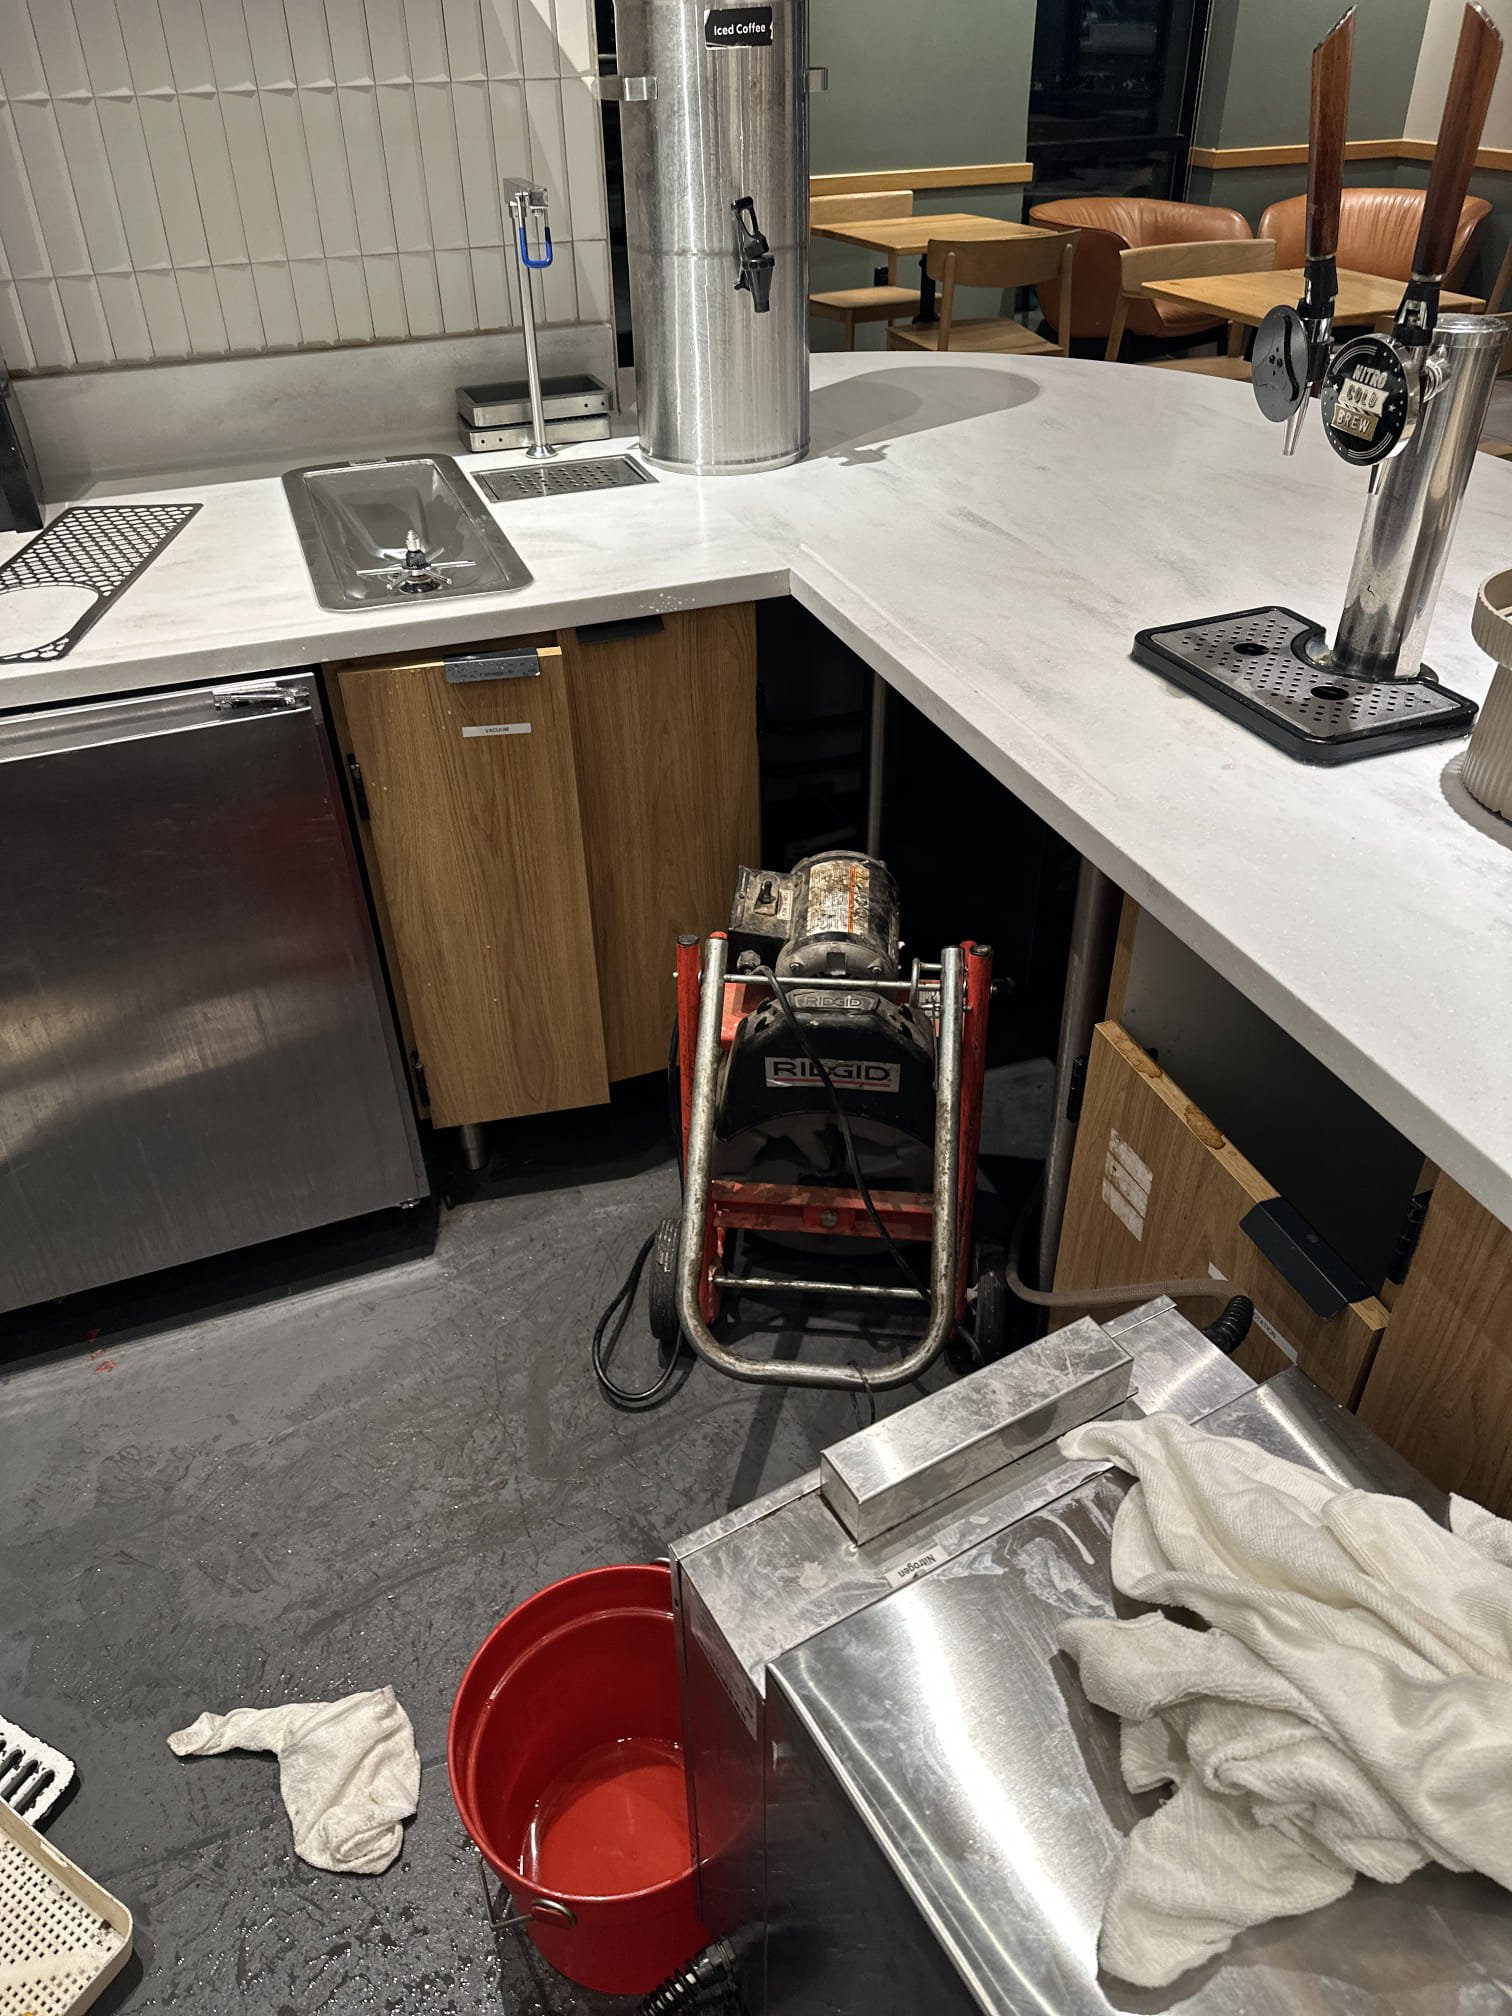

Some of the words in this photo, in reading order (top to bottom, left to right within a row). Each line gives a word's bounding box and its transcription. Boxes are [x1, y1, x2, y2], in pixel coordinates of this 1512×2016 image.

[713, 24, 735, 36] Iced
[736, 22, 766, 35] Coffee
[1352, 364, 1388, 389] NITRO
[1346, 384, 1378, 409] COLD
[1336, 410, 1371, 433] BREW
[804, 996, 864, 1008] RIDGID
[897, 1553, 937, 1577] Nitrogen
